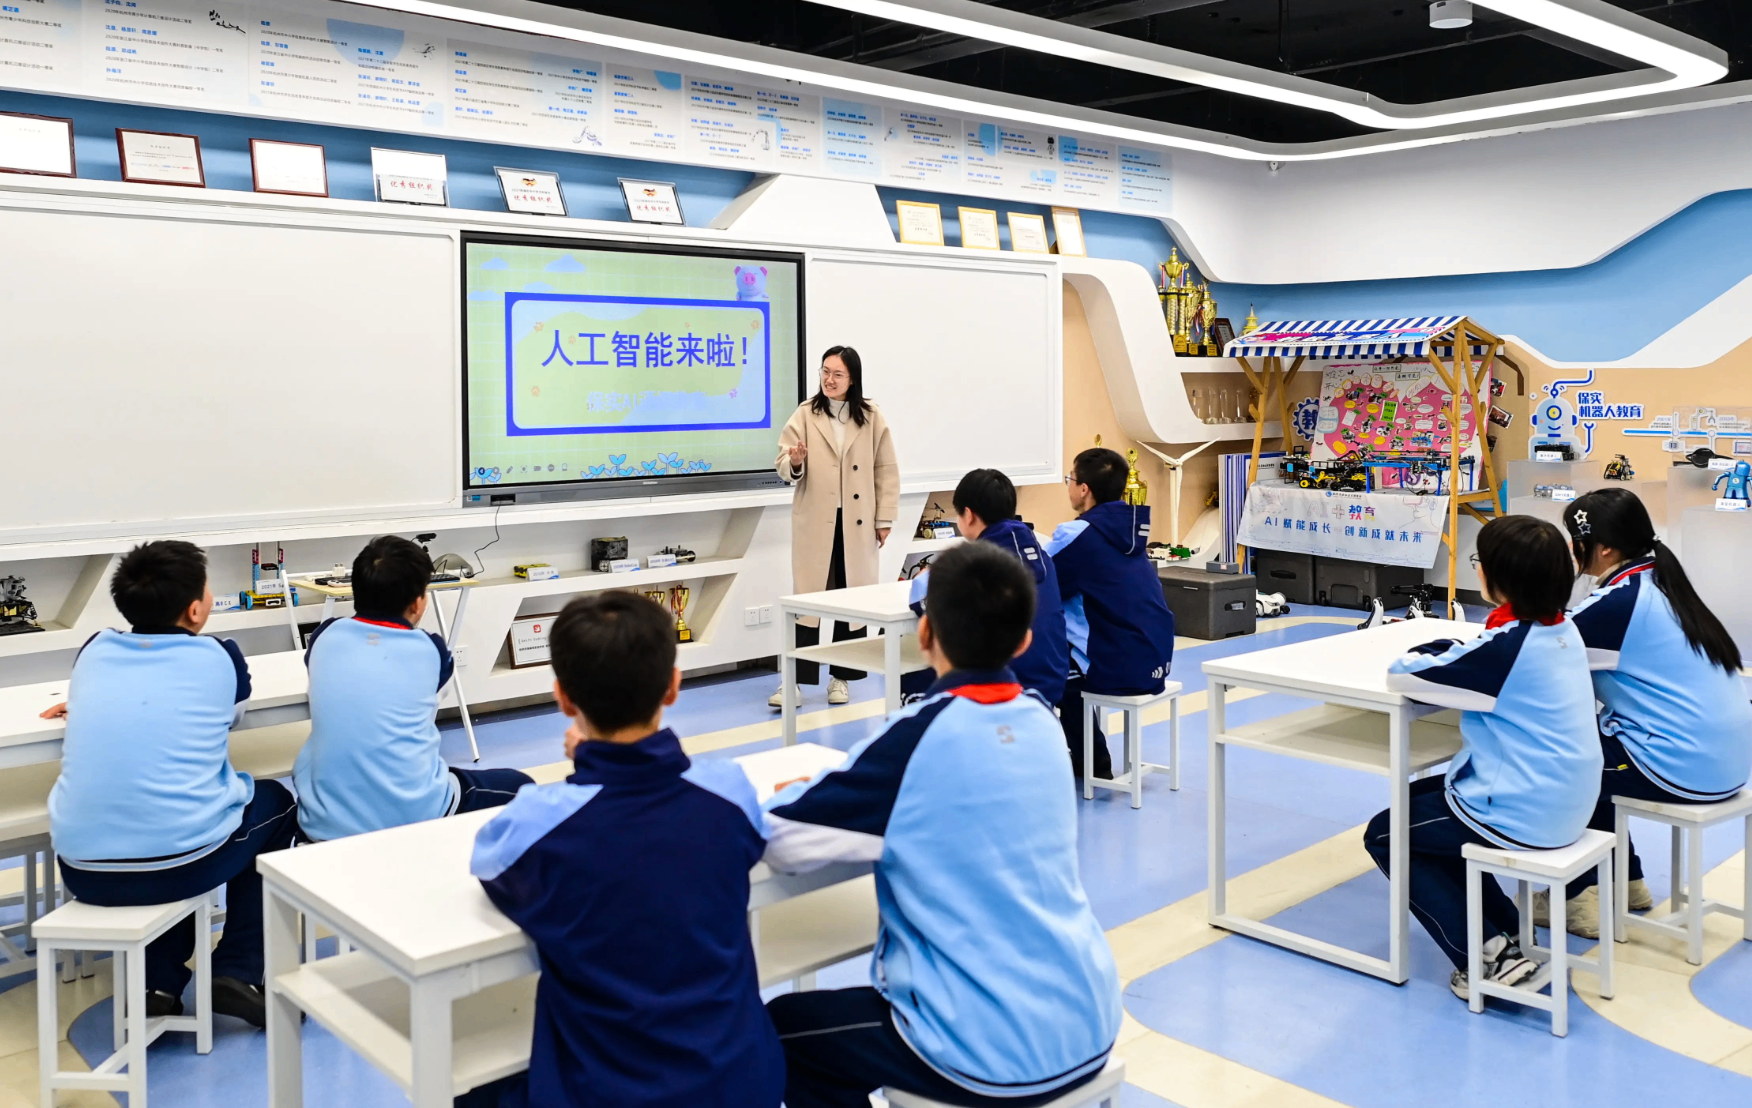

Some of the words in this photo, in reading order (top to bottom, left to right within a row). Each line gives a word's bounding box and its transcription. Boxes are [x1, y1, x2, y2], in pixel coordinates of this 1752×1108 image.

[1577, 392, 1602, 405] 保实
[1578, 405, 1642, 418] 机器人教育
[1345, 525, 1422, 543] 创新成就未来
